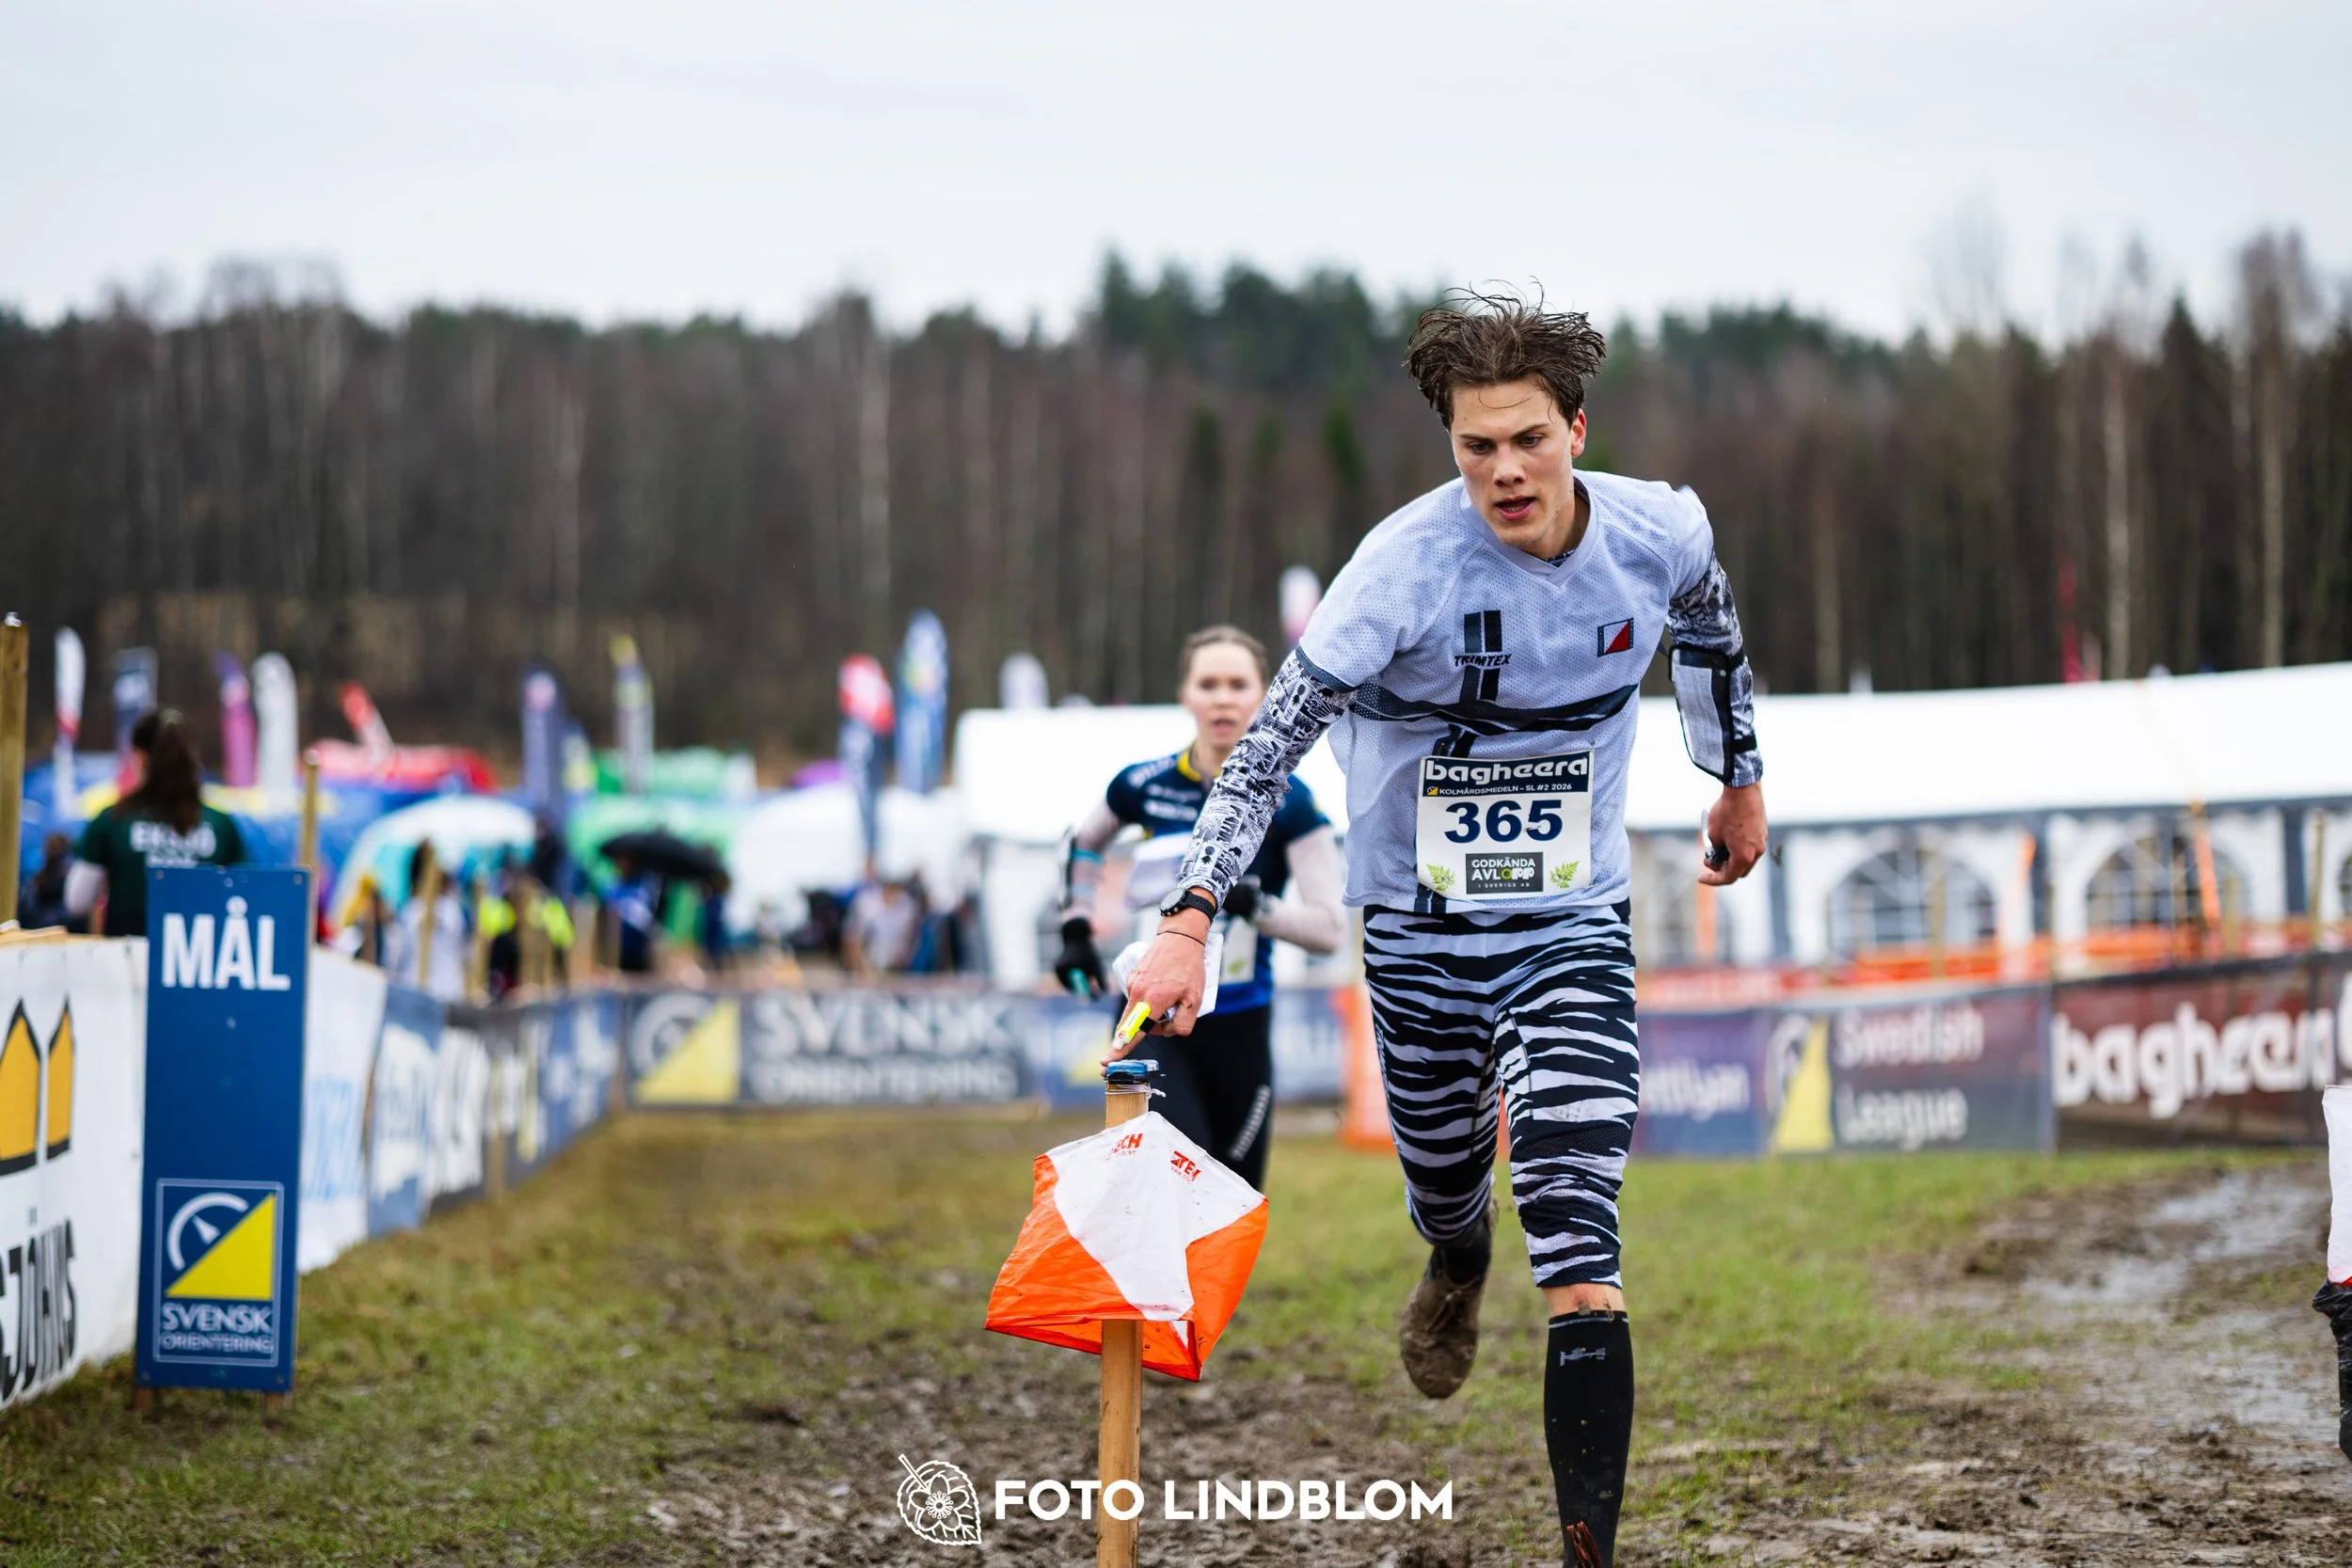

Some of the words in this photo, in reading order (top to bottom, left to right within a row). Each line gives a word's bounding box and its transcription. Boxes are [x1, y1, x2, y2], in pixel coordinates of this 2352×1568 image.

[1453, 654, 1512, 667] TRIMTEX
[1425, 758, 1588, 785] bagheera
[1439, 785, 1518, 796] KOLMÅRDSMEDELN
[1444, 800, 1564, 844] 365
[1471, 856, 1535, 868] GODKÄNDA
[162, 895, 292, 990] MÅL
[162, 1304, 273, 1333] SVENSK
[162, 1333, 274, 1354] ORIENTERING
